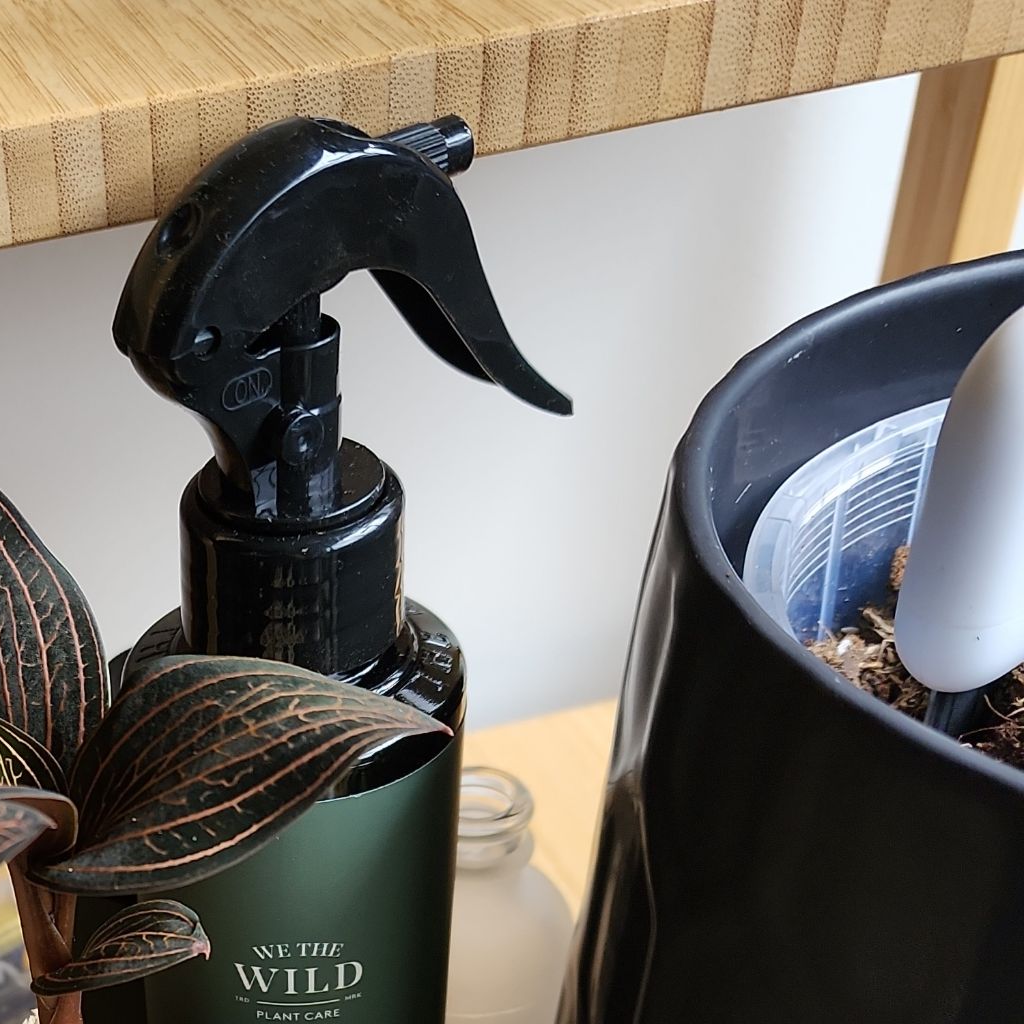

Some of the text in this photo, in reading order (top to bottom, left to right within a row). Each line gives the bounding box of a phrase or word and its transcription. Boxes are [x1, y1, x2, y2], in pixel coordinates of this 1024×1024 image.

[252, 942, 344, 960] WE THE
[233, 960, 364, 995] WILD
[256, 1008, 341, 1021] PLANT CARE
